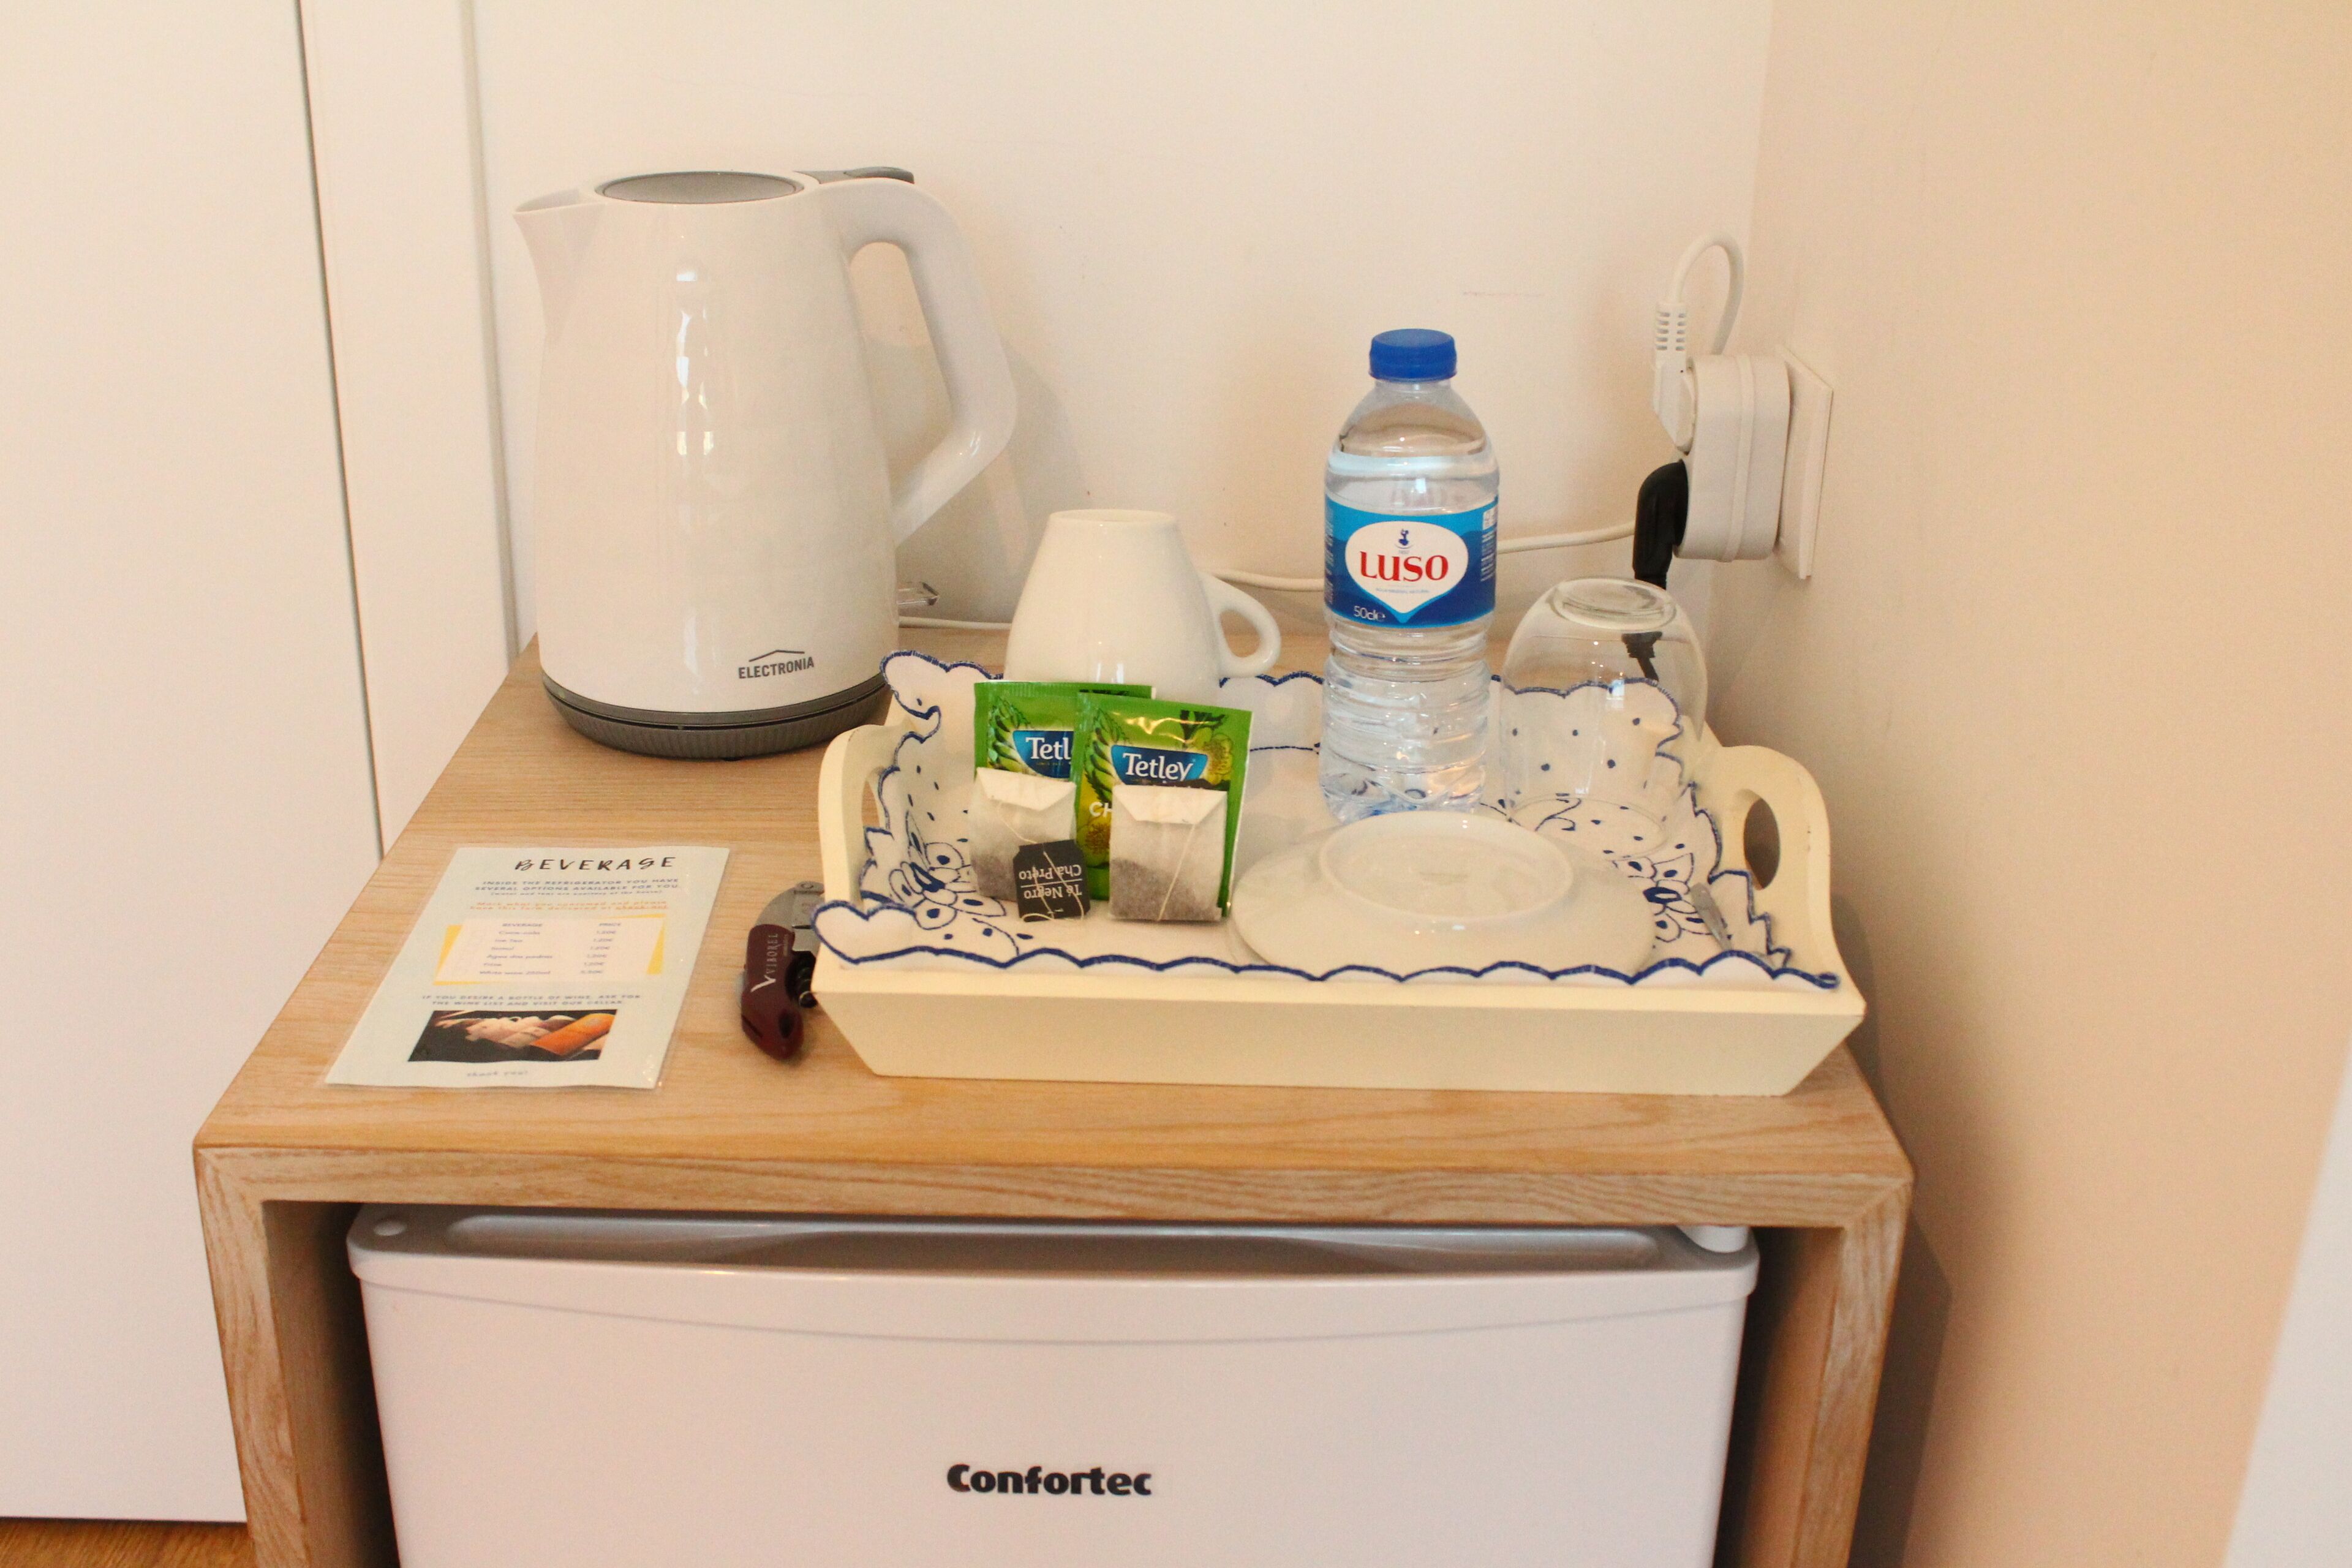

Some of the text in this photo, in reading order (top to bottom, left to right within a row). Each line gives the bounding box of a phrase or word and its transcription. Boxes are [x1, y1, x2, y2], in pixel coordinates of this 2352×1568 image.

[738, 657, 815, 679] ELECTRONIA
[1025, 737, 1071, 760] Tetl
[1122, 752, 1194, 782] Tetley
[1089, 801, 1112, 817] CH
[514, 857, 676, 872] BEVERAGE
[1023, 886, 1063, 899] Negro
[947, 1463, 1152, 1496] Confortec
